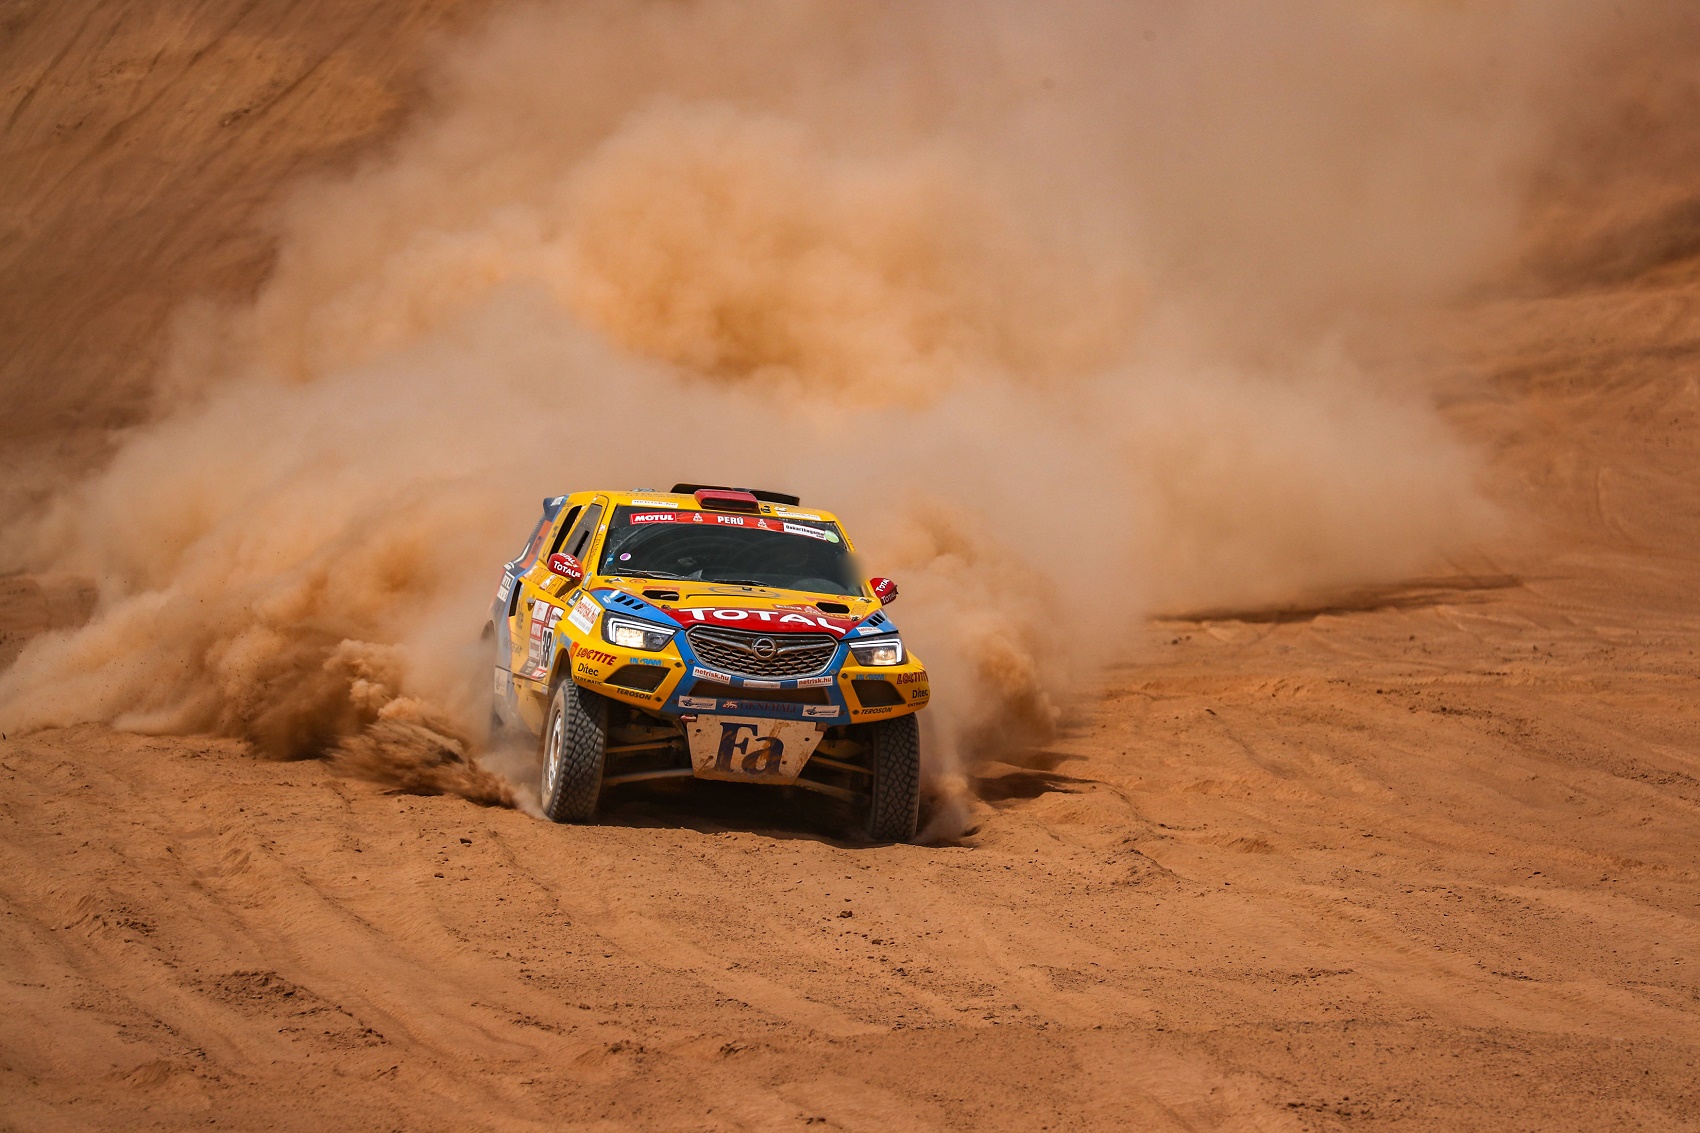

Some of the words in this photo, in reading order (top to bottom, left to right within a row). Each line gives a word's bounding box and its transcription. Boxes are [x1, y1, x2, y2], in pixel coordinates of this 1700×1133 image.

[634, 514, 674, 522] MOTUL
[717, 516, 744, 525] PERÚ
[553, 560, 577, 577] TOTAL
[678, 608, 846, 635] TOTAL
[576, 647, 617, 666] LOCTITE
[694, 668, 730, 682] netrisk.hu
[798, 677, 832, 686] netrisk.hu
[616, 688, 652, 701] TEROSON
[741, 701, 798, 713] GENERALI
[861, 707, 893, 715] TEROSON
[715, 722, 785, 775] Fa
